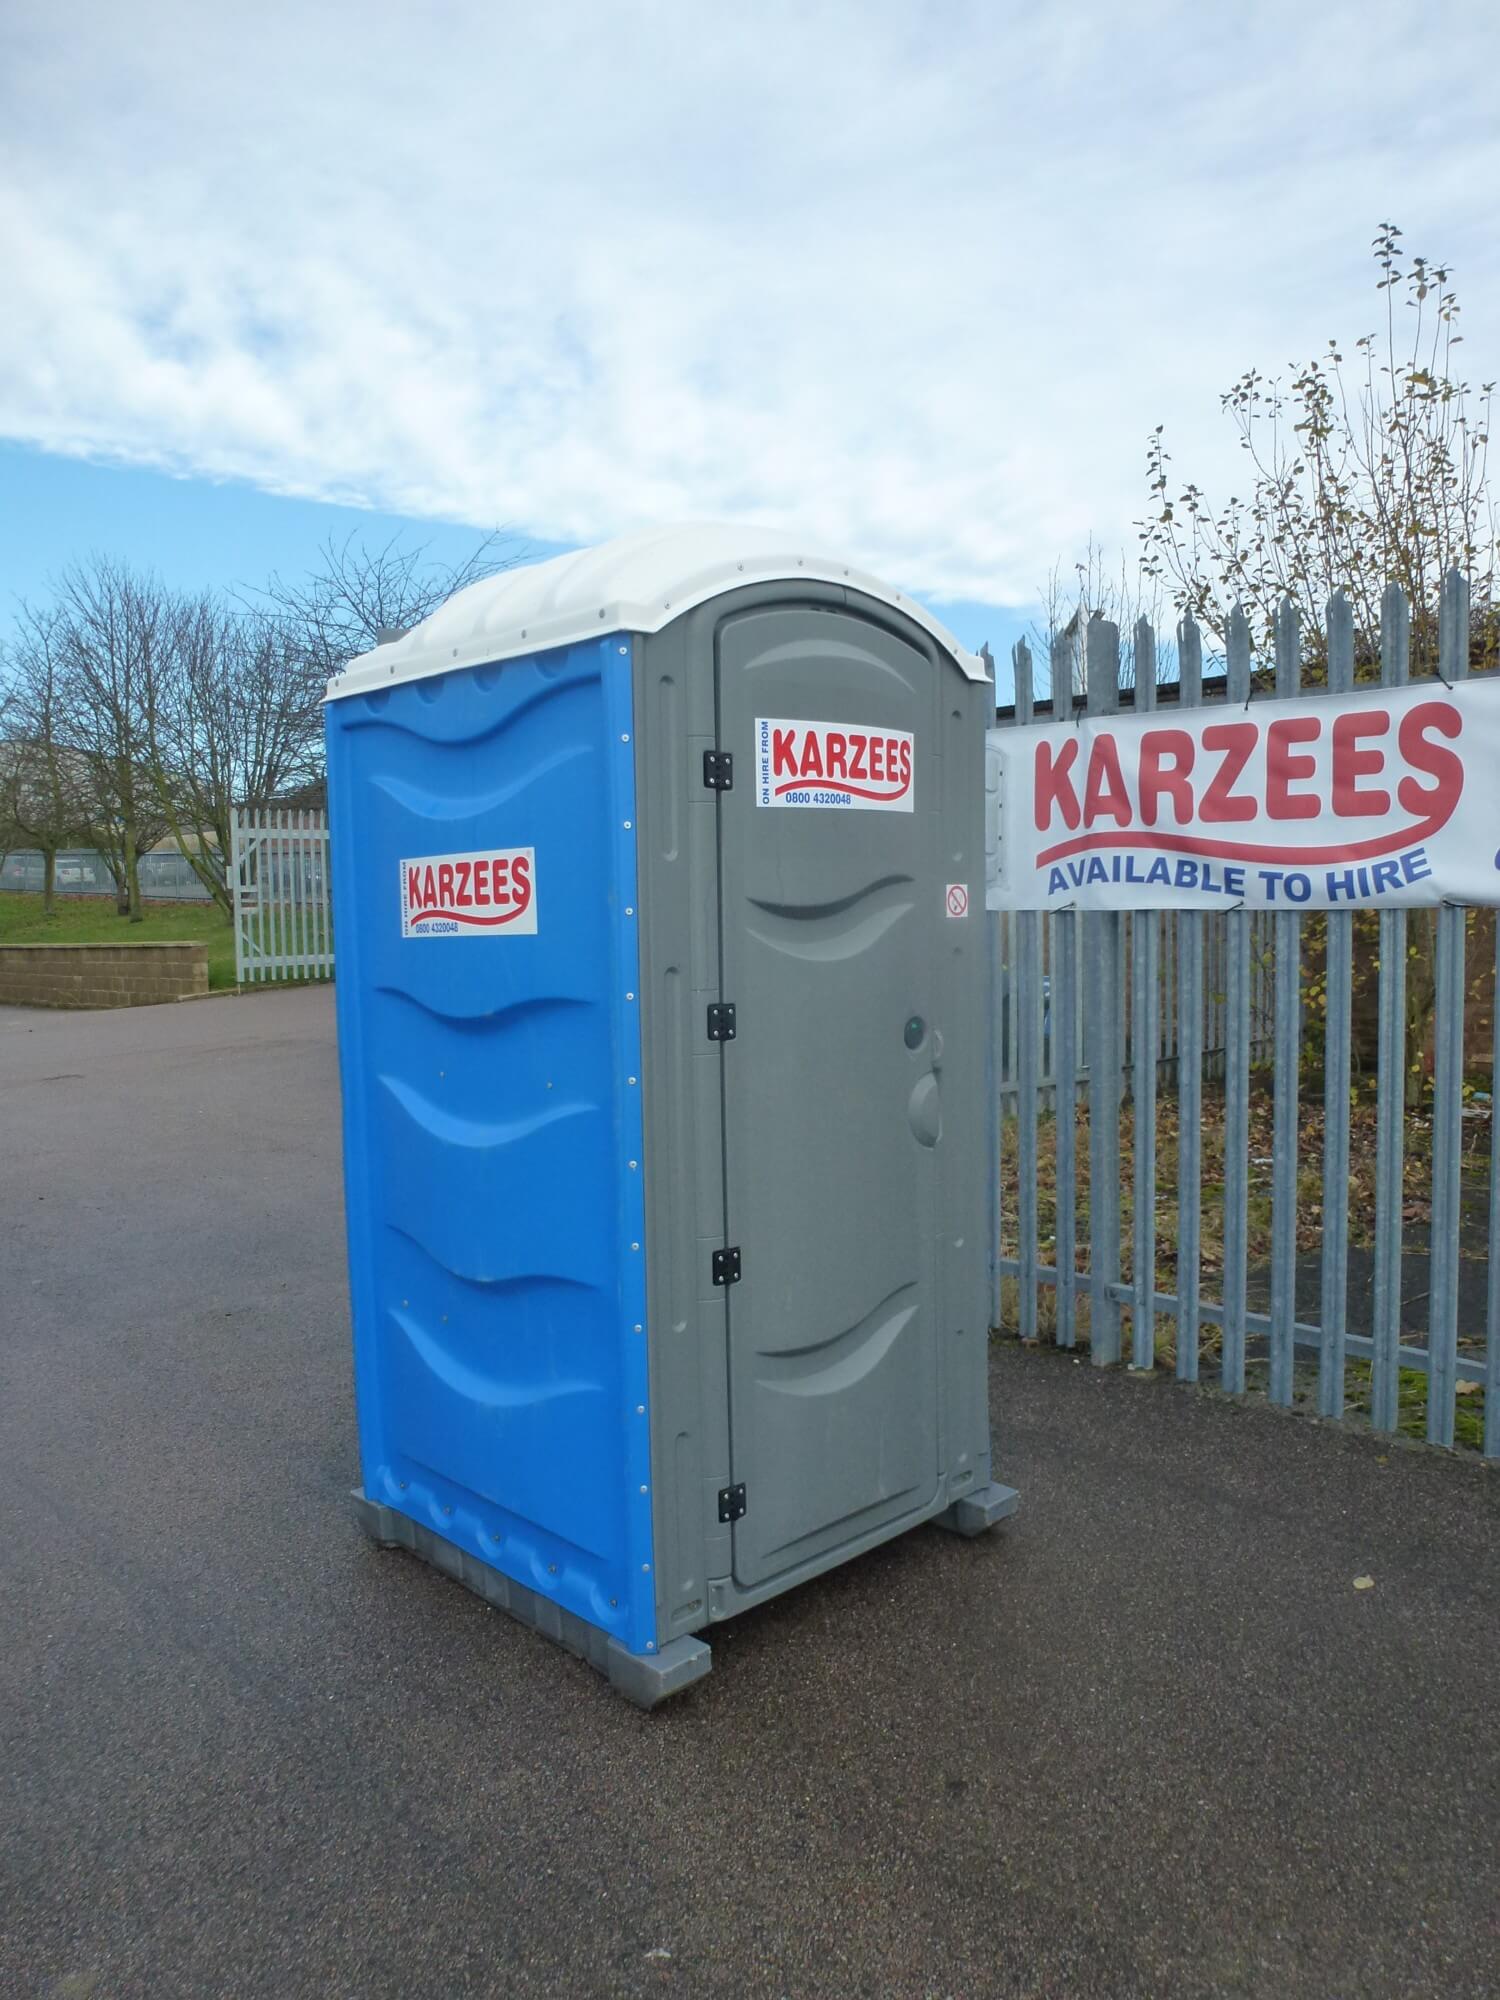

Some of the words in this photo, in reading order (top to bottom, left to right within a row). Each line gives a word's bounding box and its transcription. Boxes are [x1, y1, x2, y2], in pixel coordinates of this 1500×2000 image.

[761, 721, 769, 755] FROM
[773, 729, 911, 785] KARZEES
[761, 757, 770, 784] HIRE
[1034, 701, 1464, 831] KARZEES
[762, 788, 770, 805] ON
[785, 792, 810, 804] 0800
[813, 793, 851, 805] 4320048
[408, 856, 531, 910] KARZEES
[1048, 855, 1246, 897] AVAILABLE
[1258, 871, 1312, 902] TO
[1326, 847, 1432, 901] HIRE
